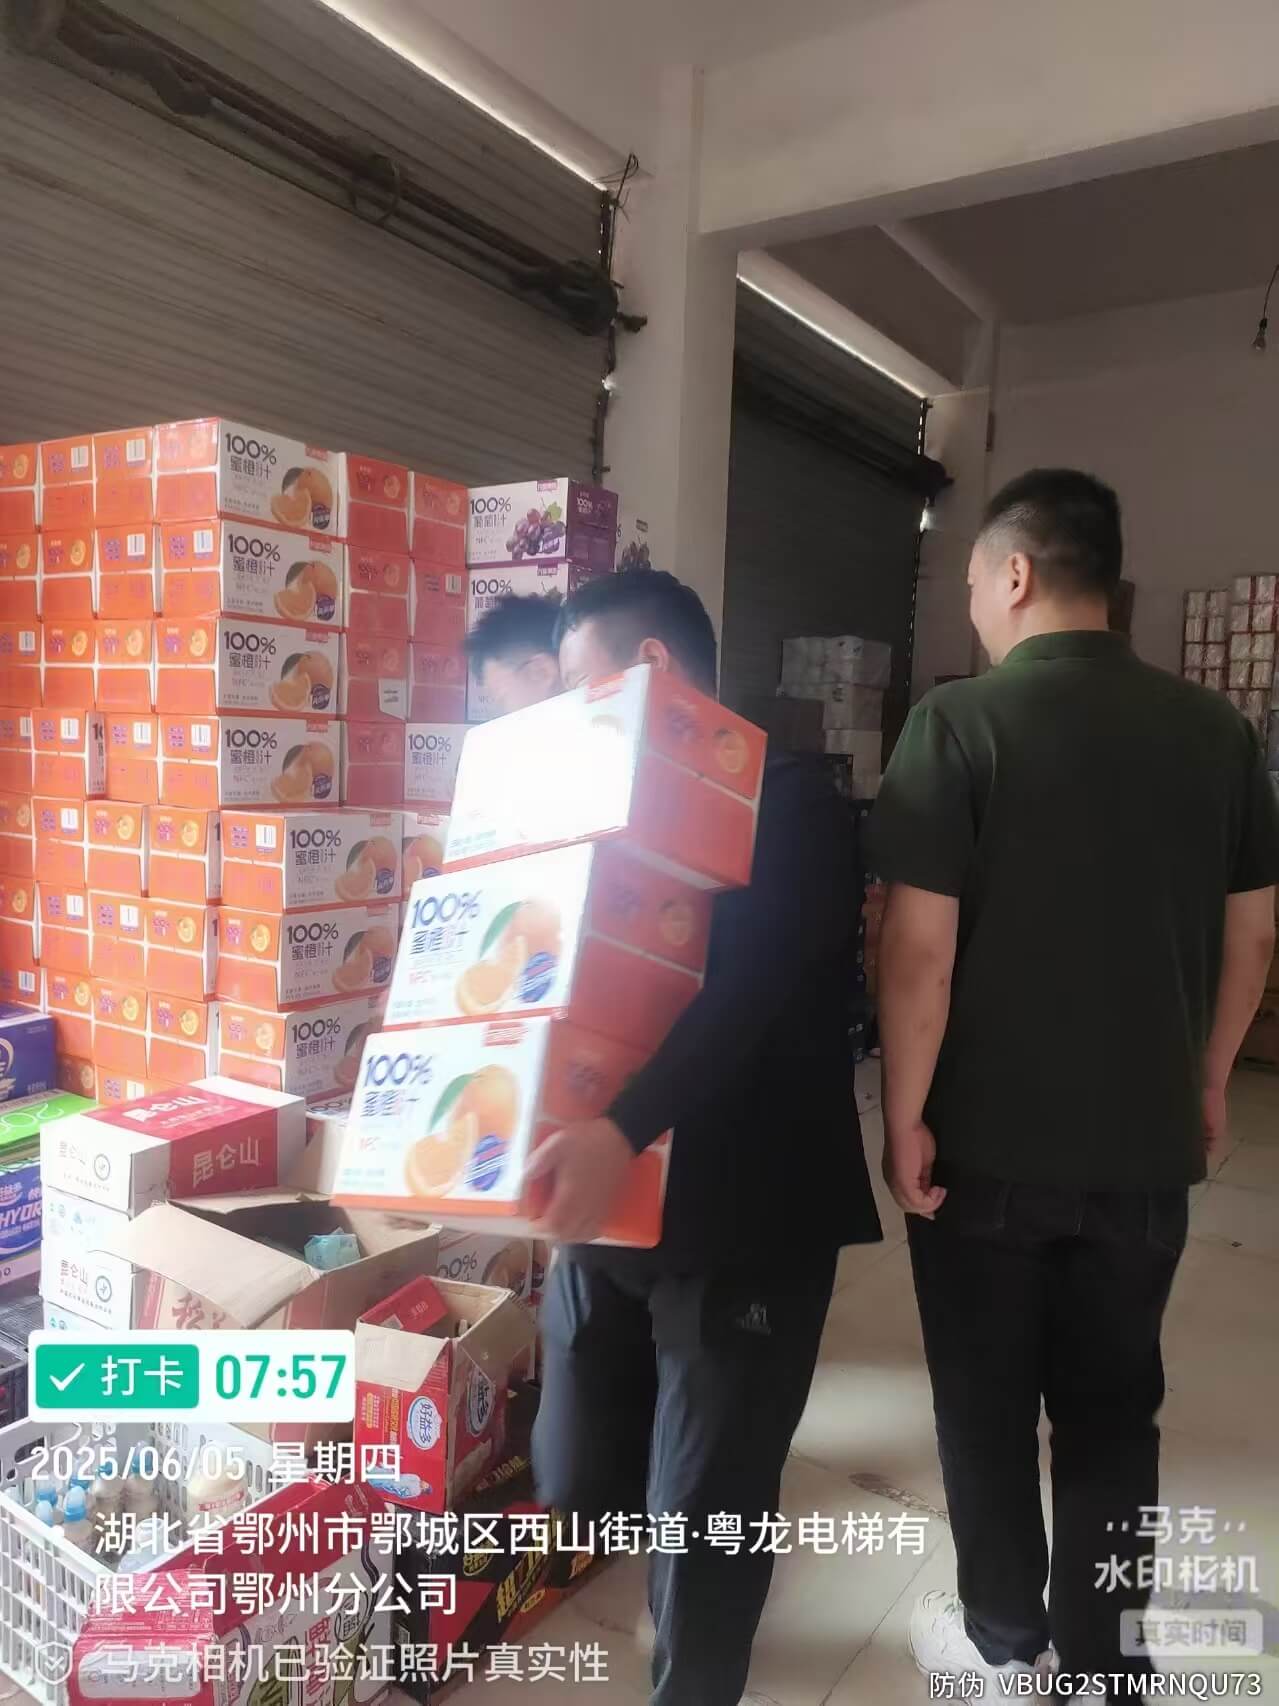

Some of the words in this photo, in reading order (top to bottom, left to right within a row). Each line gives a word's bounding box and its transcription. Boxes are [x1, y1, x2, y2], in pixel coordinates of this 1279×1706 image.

[225, 433, 277, 465] 100%
[470, 497, 511, 514] 100%
[228, 533, 281, 562] 100%
[472, 579, 512, 595] 100%
[224, 631, 277, 658] 100%
[225, 729, 277, 749] 100%
[408, 733, 452, 752] 100%
[290, 829, 342, 849] 100%
[411, 890, 482, 929] 100%
[287, 922, 339, 943] 100%
[291, 1016, 341, 1044] 100%
[363, 1052, 437, 1087] 100%
[193, 1136, 259, 1188] 昆仑山
